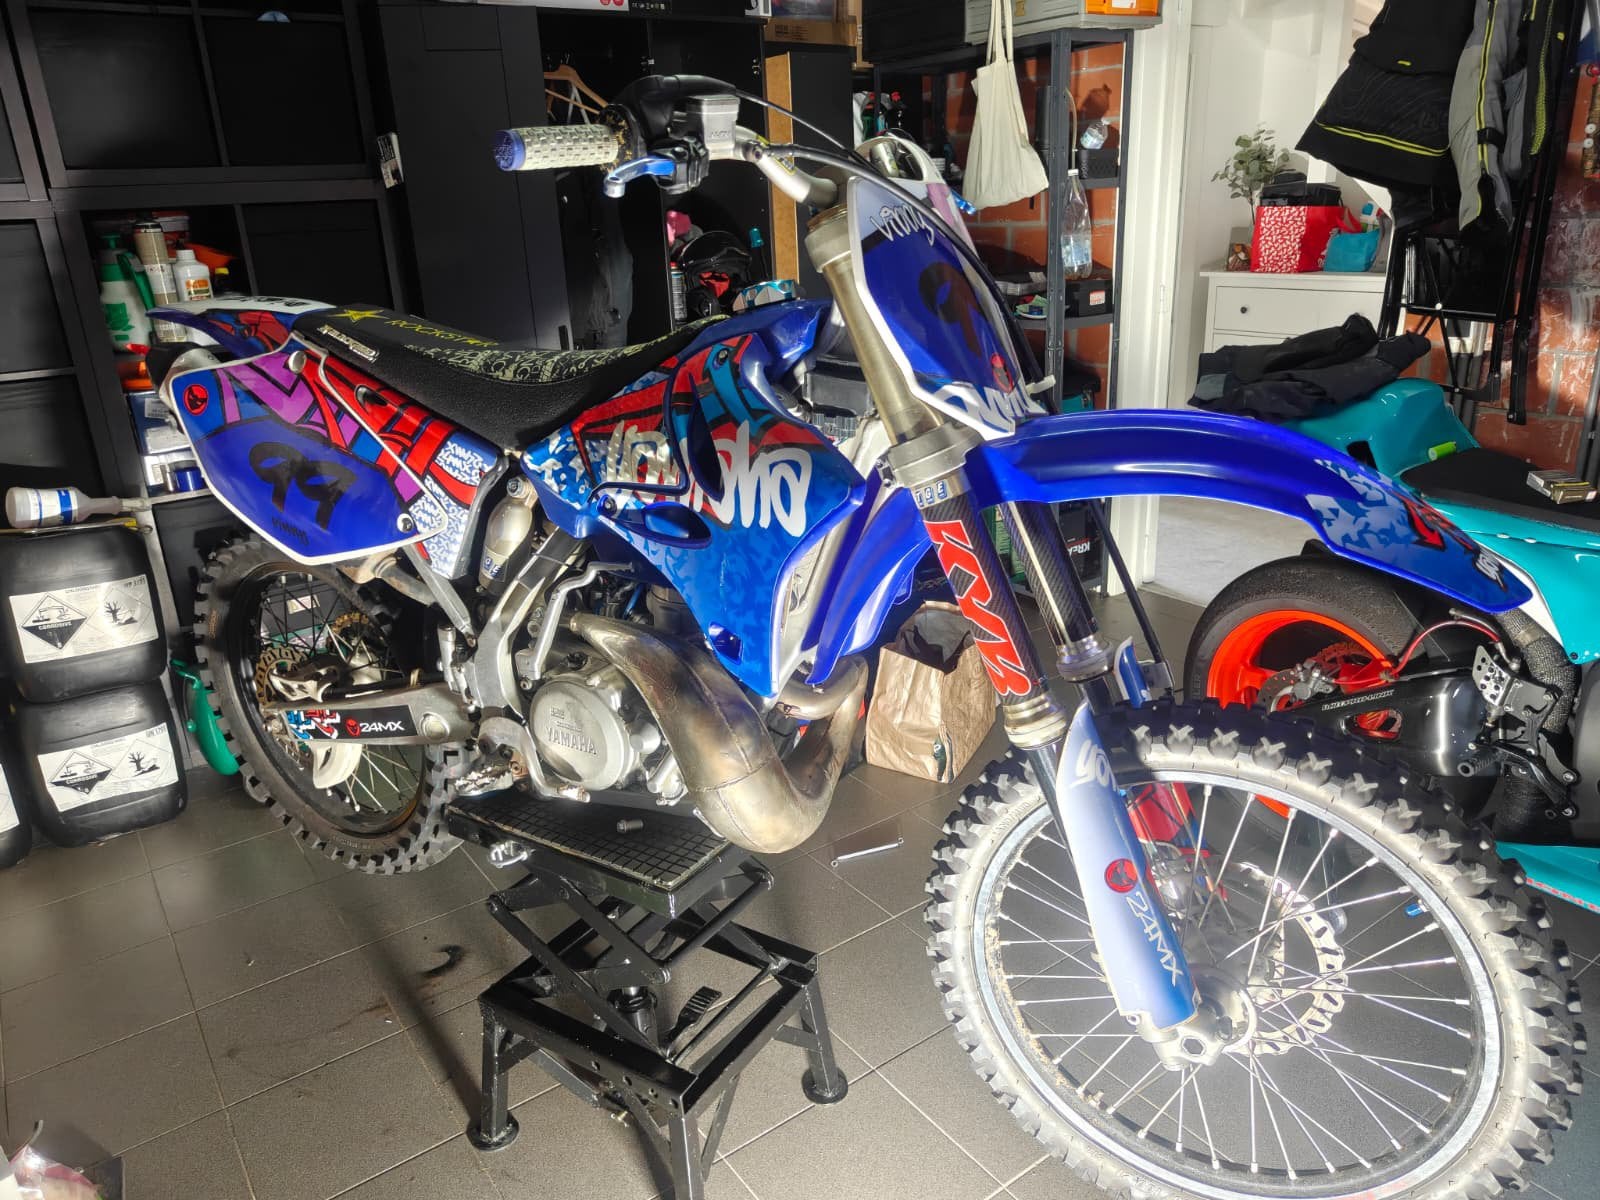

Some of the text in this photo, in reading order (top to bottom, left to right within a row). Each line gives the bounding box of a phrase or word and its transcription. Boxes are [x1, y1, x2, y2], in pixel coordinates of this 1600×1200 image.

[248, 441, 357, 532] 99
[924, 520, 1031, 696] KYB
[359, 720, 405, 733] 24MX
[546, 726, 597, 756] YAMAHA
[1126, 891, 1184, 987] 24MX
